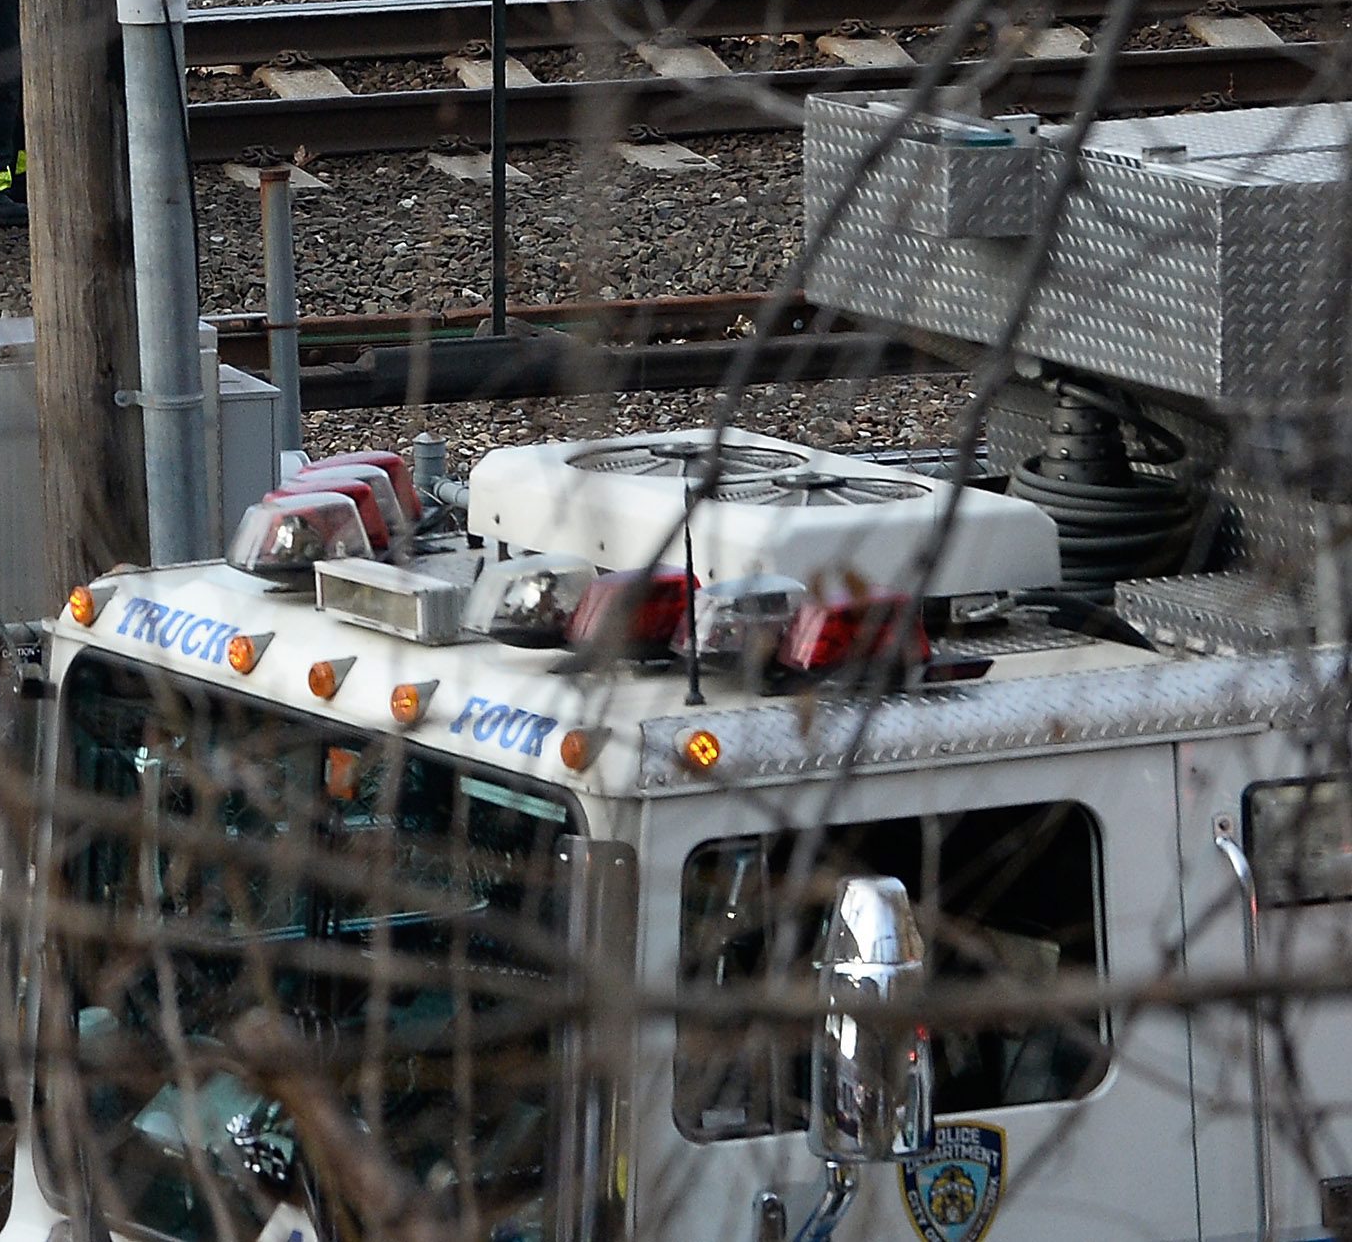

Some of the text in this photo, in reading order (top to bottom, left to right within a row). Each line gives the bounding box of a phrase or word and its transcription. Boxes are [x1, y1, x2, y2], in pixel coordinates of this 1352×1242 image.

[116, 597, 558, 757] TRUCK FOUR
[935, 1125, 980, 1145] OLICE
